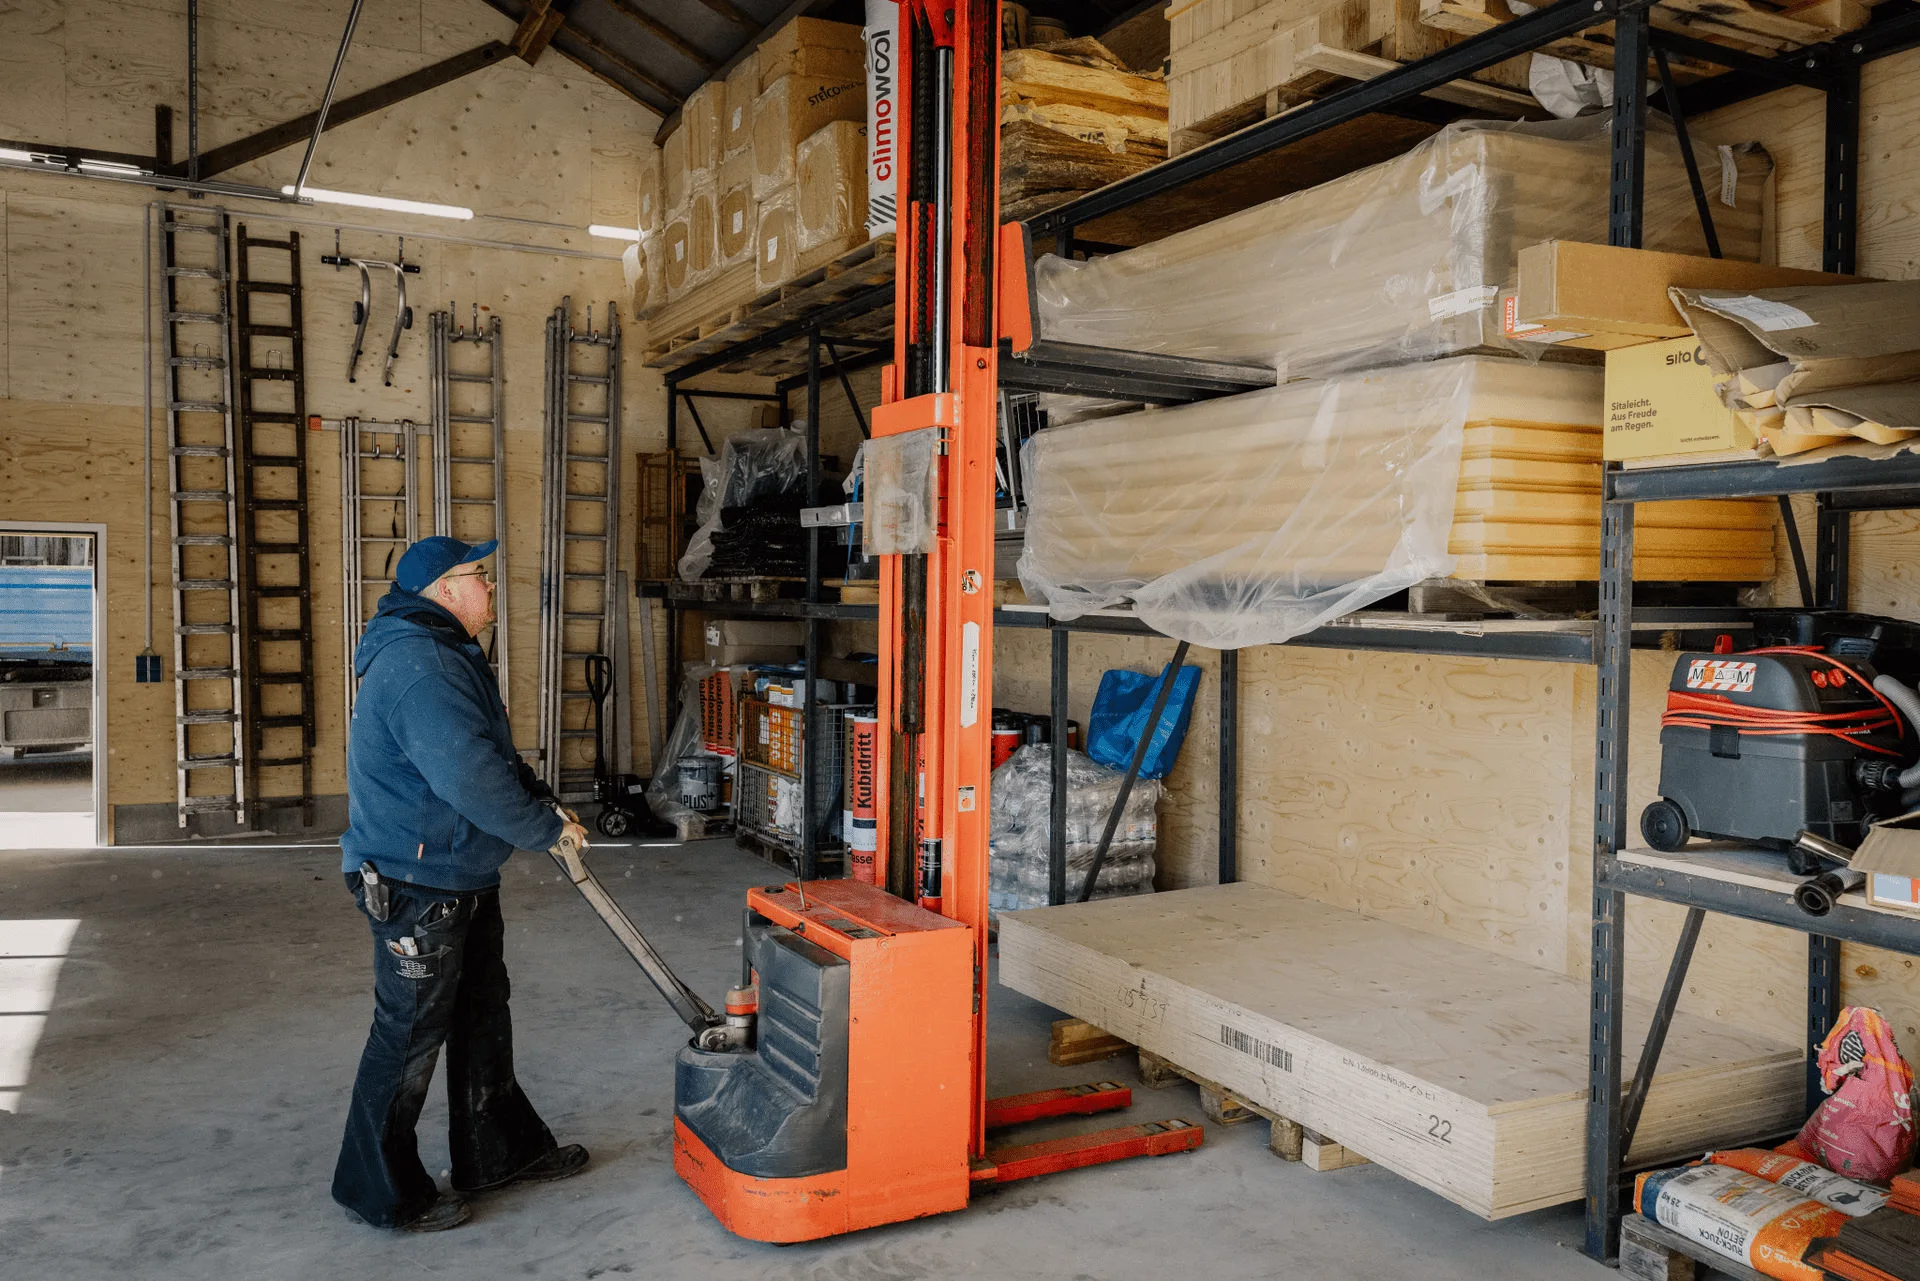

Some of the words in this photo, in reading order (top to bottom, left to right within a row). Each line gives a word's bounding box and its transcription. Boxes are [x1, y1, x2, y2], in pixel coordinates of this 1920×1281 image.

[871, 29, 892, 182] climowool
[1506, 298, 1514, 331] VELUX
[1611, 398, 1651, 411] Sitaleicht.
[1610, 413, 1626, 422] Aus
[1628, 408, 1657, 420] Freude
[1610, 424, 1623, 433] am
[1625, 421, 1653, 432] Regen.
[1692, 668, 1704, 680] M
[1737, 671, 1749, 683] M
[857, 732, 872, 809] Kubidritt
[850, 854, 873, 865] asse
[1428, 1114, 1452, 1144] 22
[1671, 1197, 1681, 1208] 25
[1698, 1227, 1744, 1257] RUCK-ZUCK
[1717, 1226, 1745, 1247] BETON
